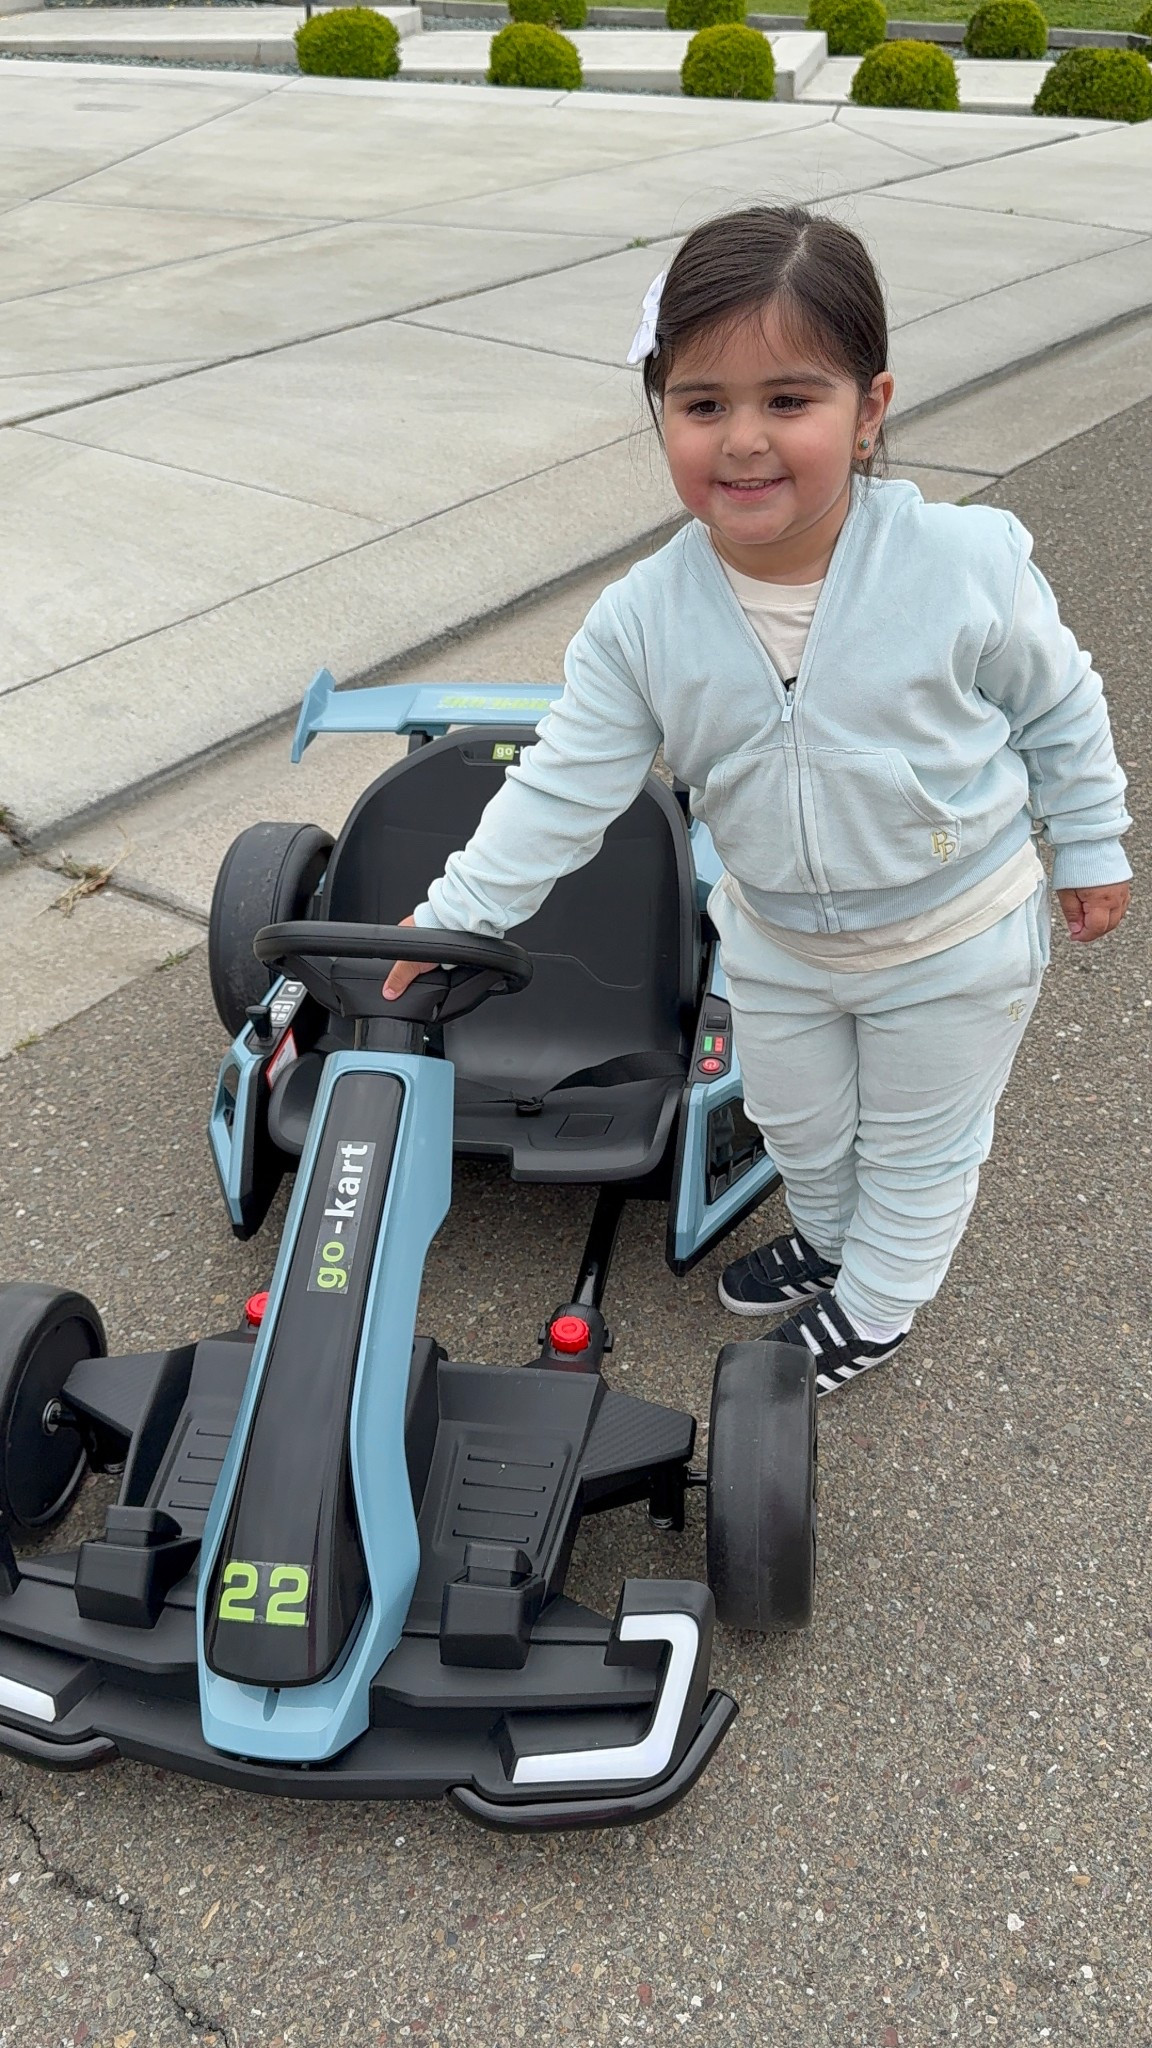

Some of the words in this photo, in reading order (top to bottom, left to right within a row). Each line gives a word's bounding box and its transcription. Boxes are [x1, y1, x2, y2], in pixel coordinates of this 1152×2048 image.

[496, 746, 524, 758] go-
[317, 1143, 368, 1289] go-kart
[219, 1562, 309, 1625] 22
